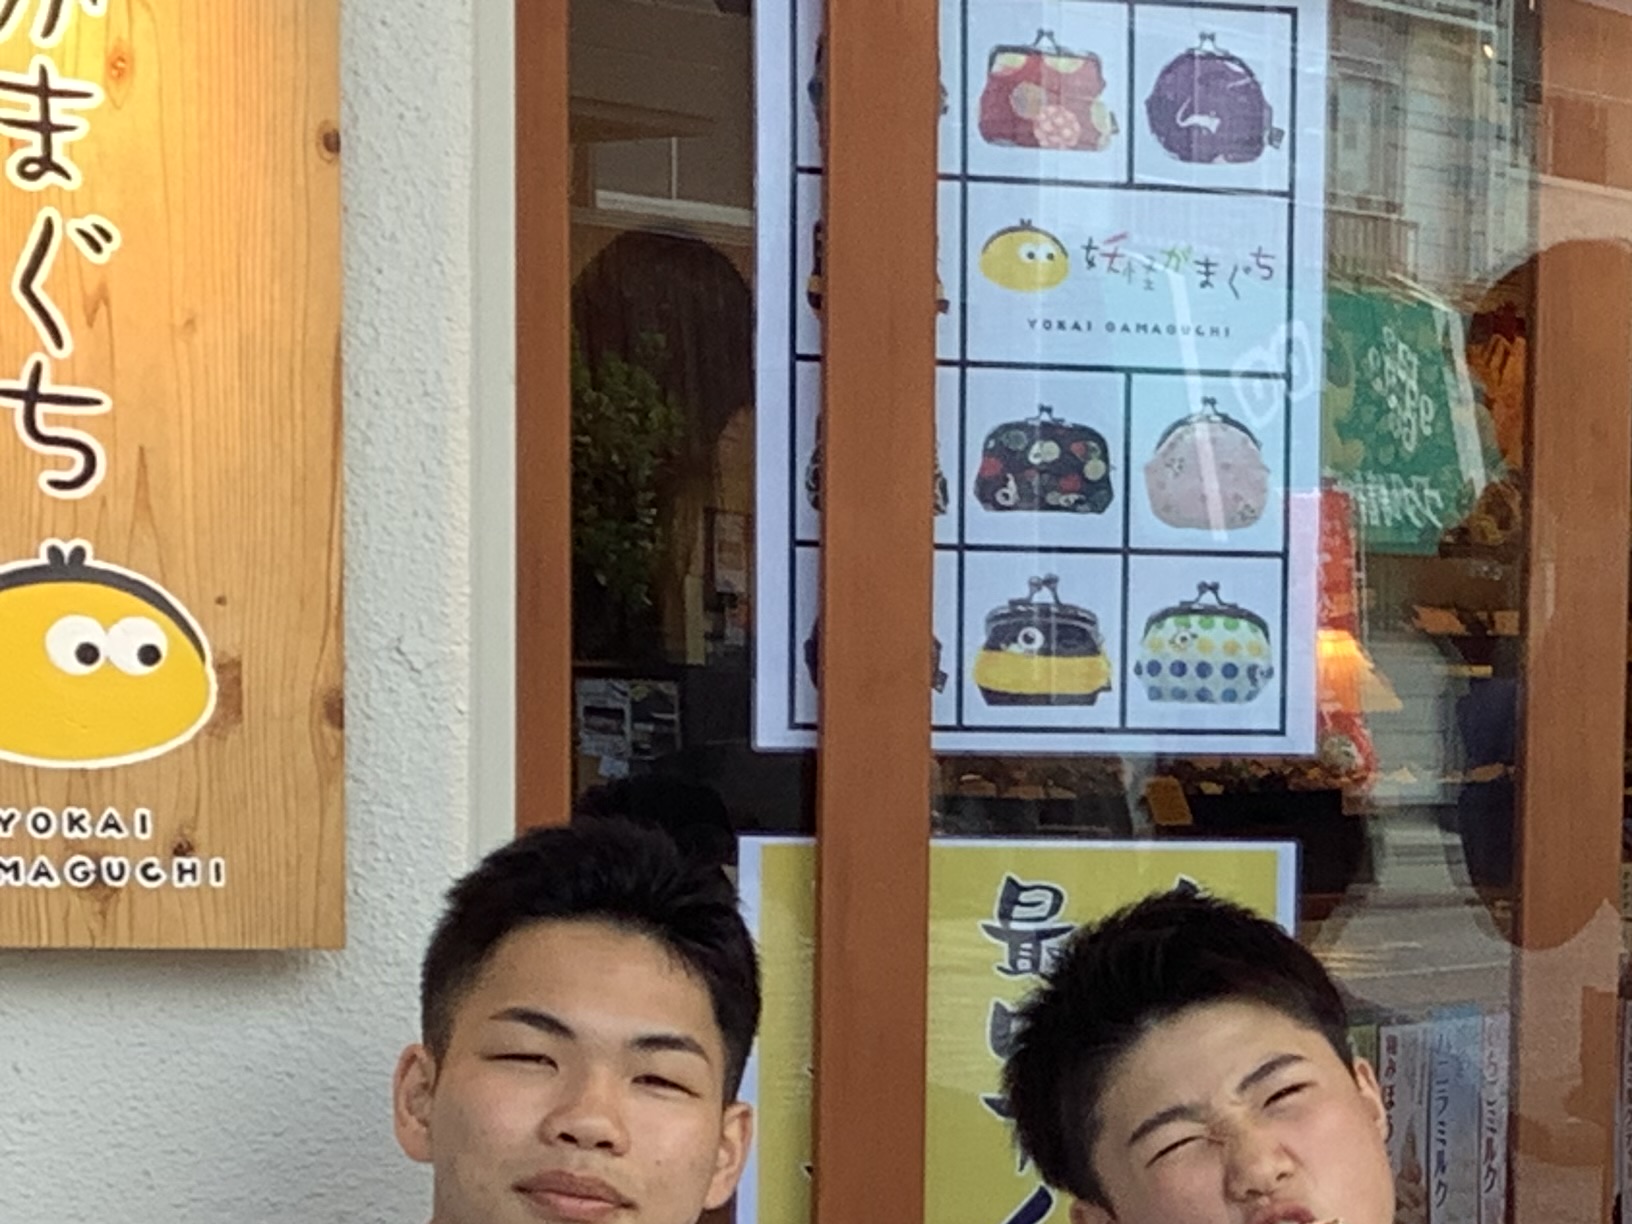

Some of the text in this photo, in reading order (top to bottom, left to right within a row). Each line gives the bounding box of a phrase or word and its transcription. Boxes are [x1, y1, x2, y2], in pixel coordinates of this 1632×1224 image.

[1081, 231, 1276, 299] 妖怪がまぐち
[1027, 318, 1231, 338] YOKAI GAMAGUCHI
[0, 811, 149, 836] YOKAI
